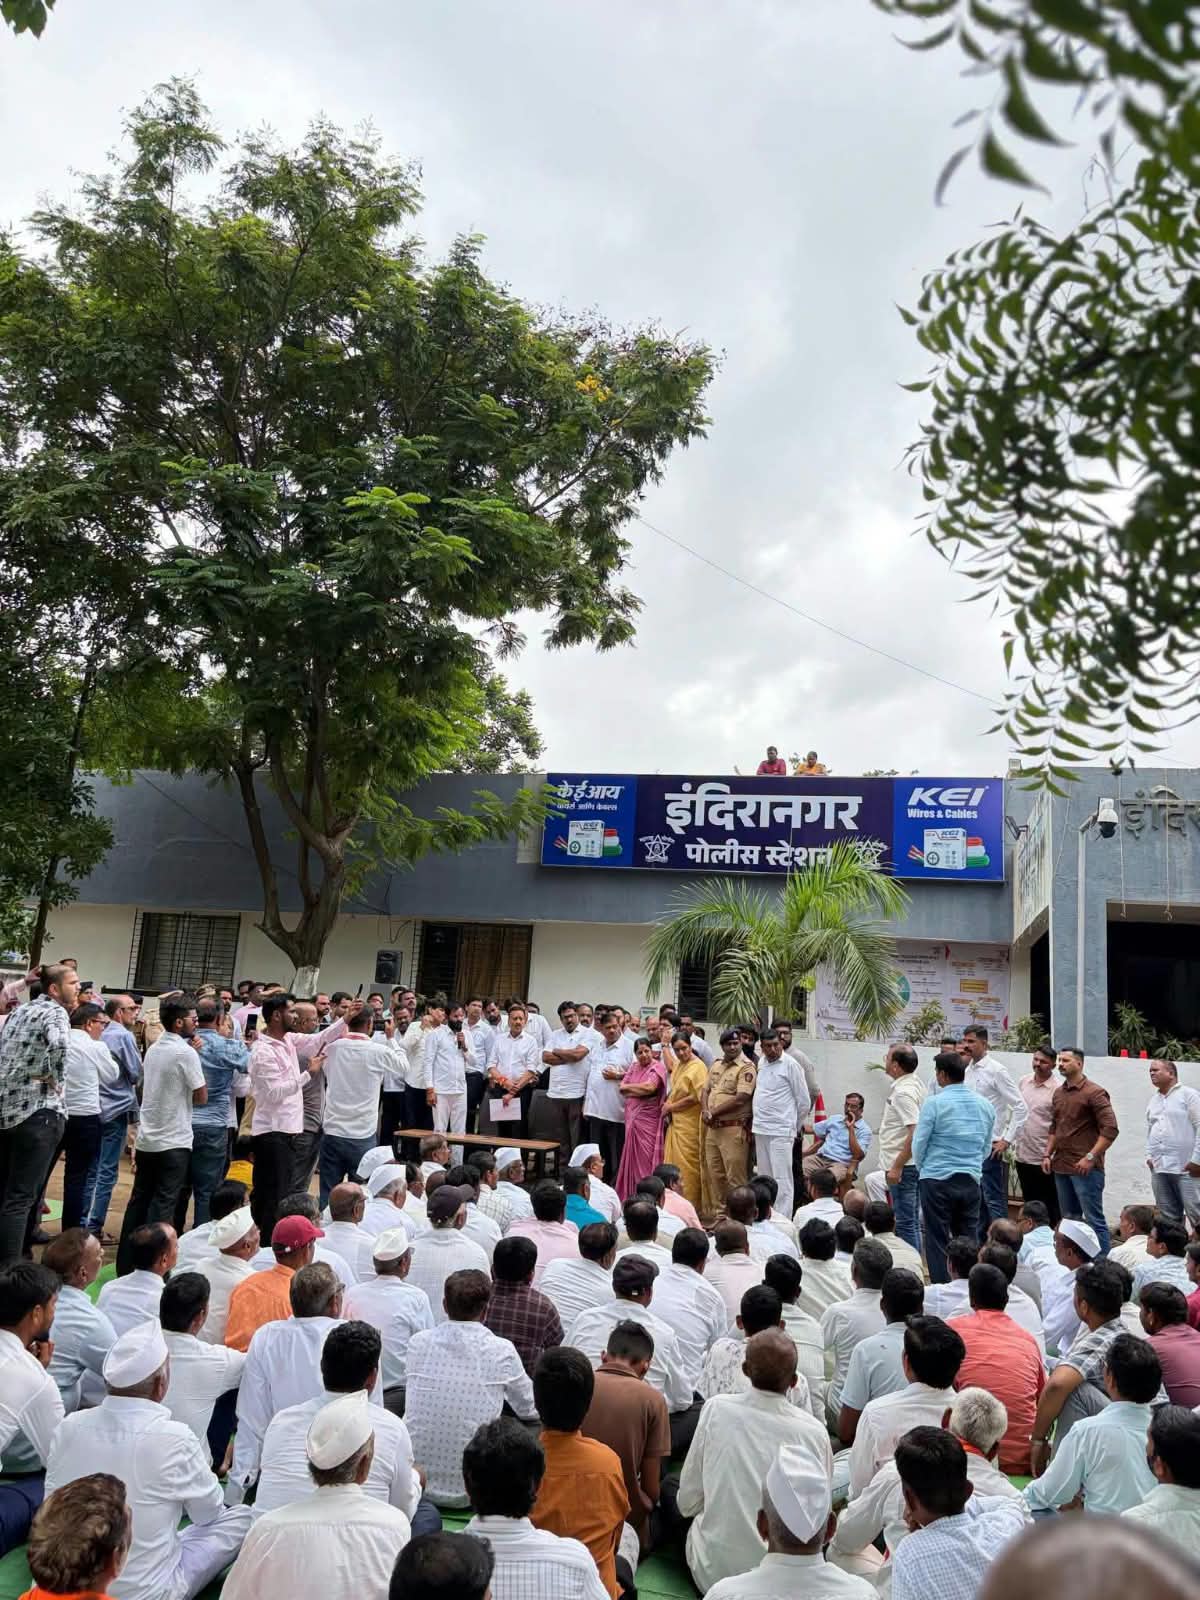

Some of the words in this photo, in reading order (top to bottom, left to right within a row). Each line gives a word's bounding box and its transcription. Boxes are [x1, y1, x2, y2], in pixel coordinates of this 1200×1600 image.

[664, 782, 863, 835] इंदिरानगर
[907, 787, 985, 806] KEI
[907, 808, 935, 818] Wires
[936, 809, 944, 818] &
[945, 809, 978, 819] Cables
[685, 837, 761, 865] पोलीस
[765, 840, 833, 867] स्टेशन
